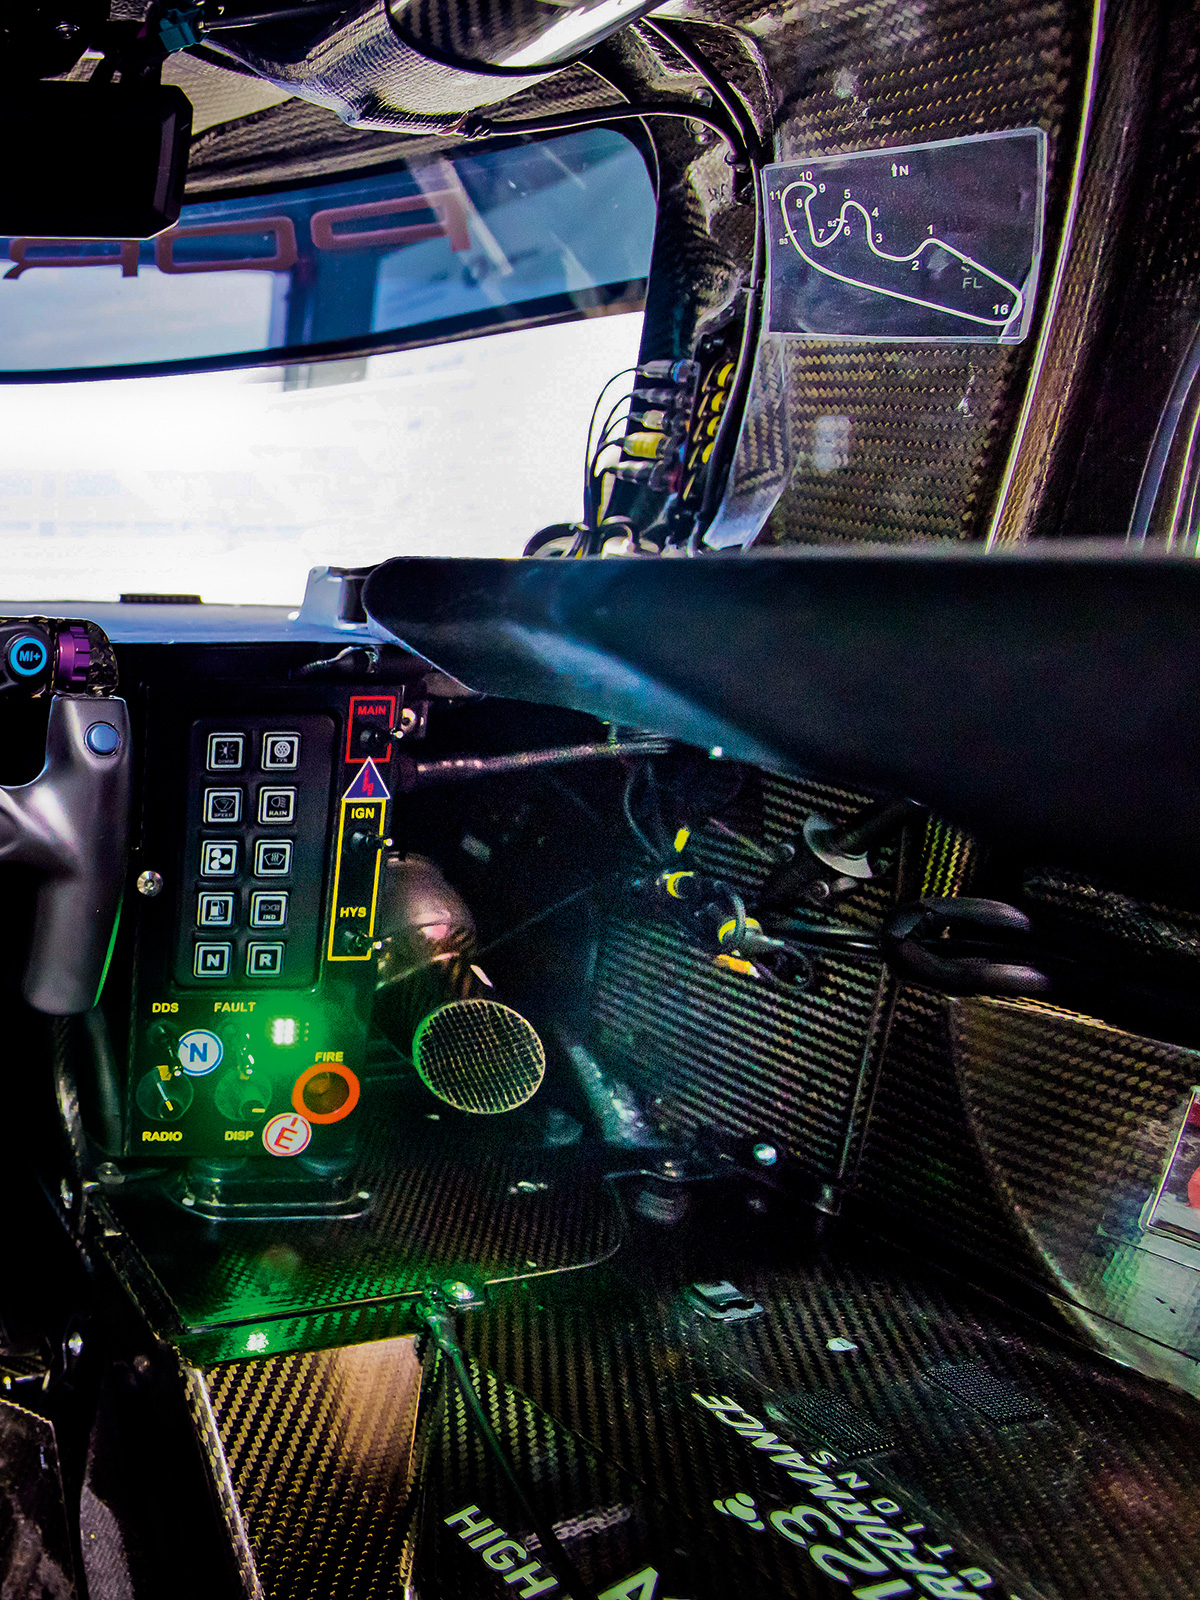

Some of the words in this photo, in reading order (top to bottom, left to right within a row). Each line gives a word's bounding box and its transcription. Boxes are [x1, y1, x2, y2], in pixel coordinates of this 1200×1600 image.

[799, 171, 813, 181] 10
[899, 165, 909, 176] N
[818, 183, 826, 193] 9
[769, 190, 781, 201] 11
[844, 189, 851, 199] 5
[796, 198, 803, 208] 8
[872, 207, 879, 218] 4
[818, 229, 825, 238] 7
[843, 226, 851, 236] 6
[926, 224, 934, 235] 1
[875, 233, 883, 243] 3
[911, 260, 920, 271] 2
[962, 277, 983, 289] FL
[992, 304, 1009, 315] 16
[19, 650, 40, 662] MI+
[357, 705, 387, 716] MAIN
[351, 807, 375, 819] IGN
[339, 906, 367, 918] HYS
[206, 954, 220, 967] N
[259, 954, 272, 967] R
[152, 1002, 179, 1013] DDS
[214, 1002, 256, 1013] FAULT
[189, 1042, 207, 1063] N
[315, 1051, 344, 1062] FIRE
[142, 1131, 182, 1141] RADIO
[224, 1131, 254, 1141] DISP
[274, 1126, 298, 1150] E
[692, 1393, 984, 1600] RFORMANCE
[811, 1450, 994, 1590] UTIONS
[444, 1504, 560, 1600] HIGH
[769, 1504, 913, 1600] 123
